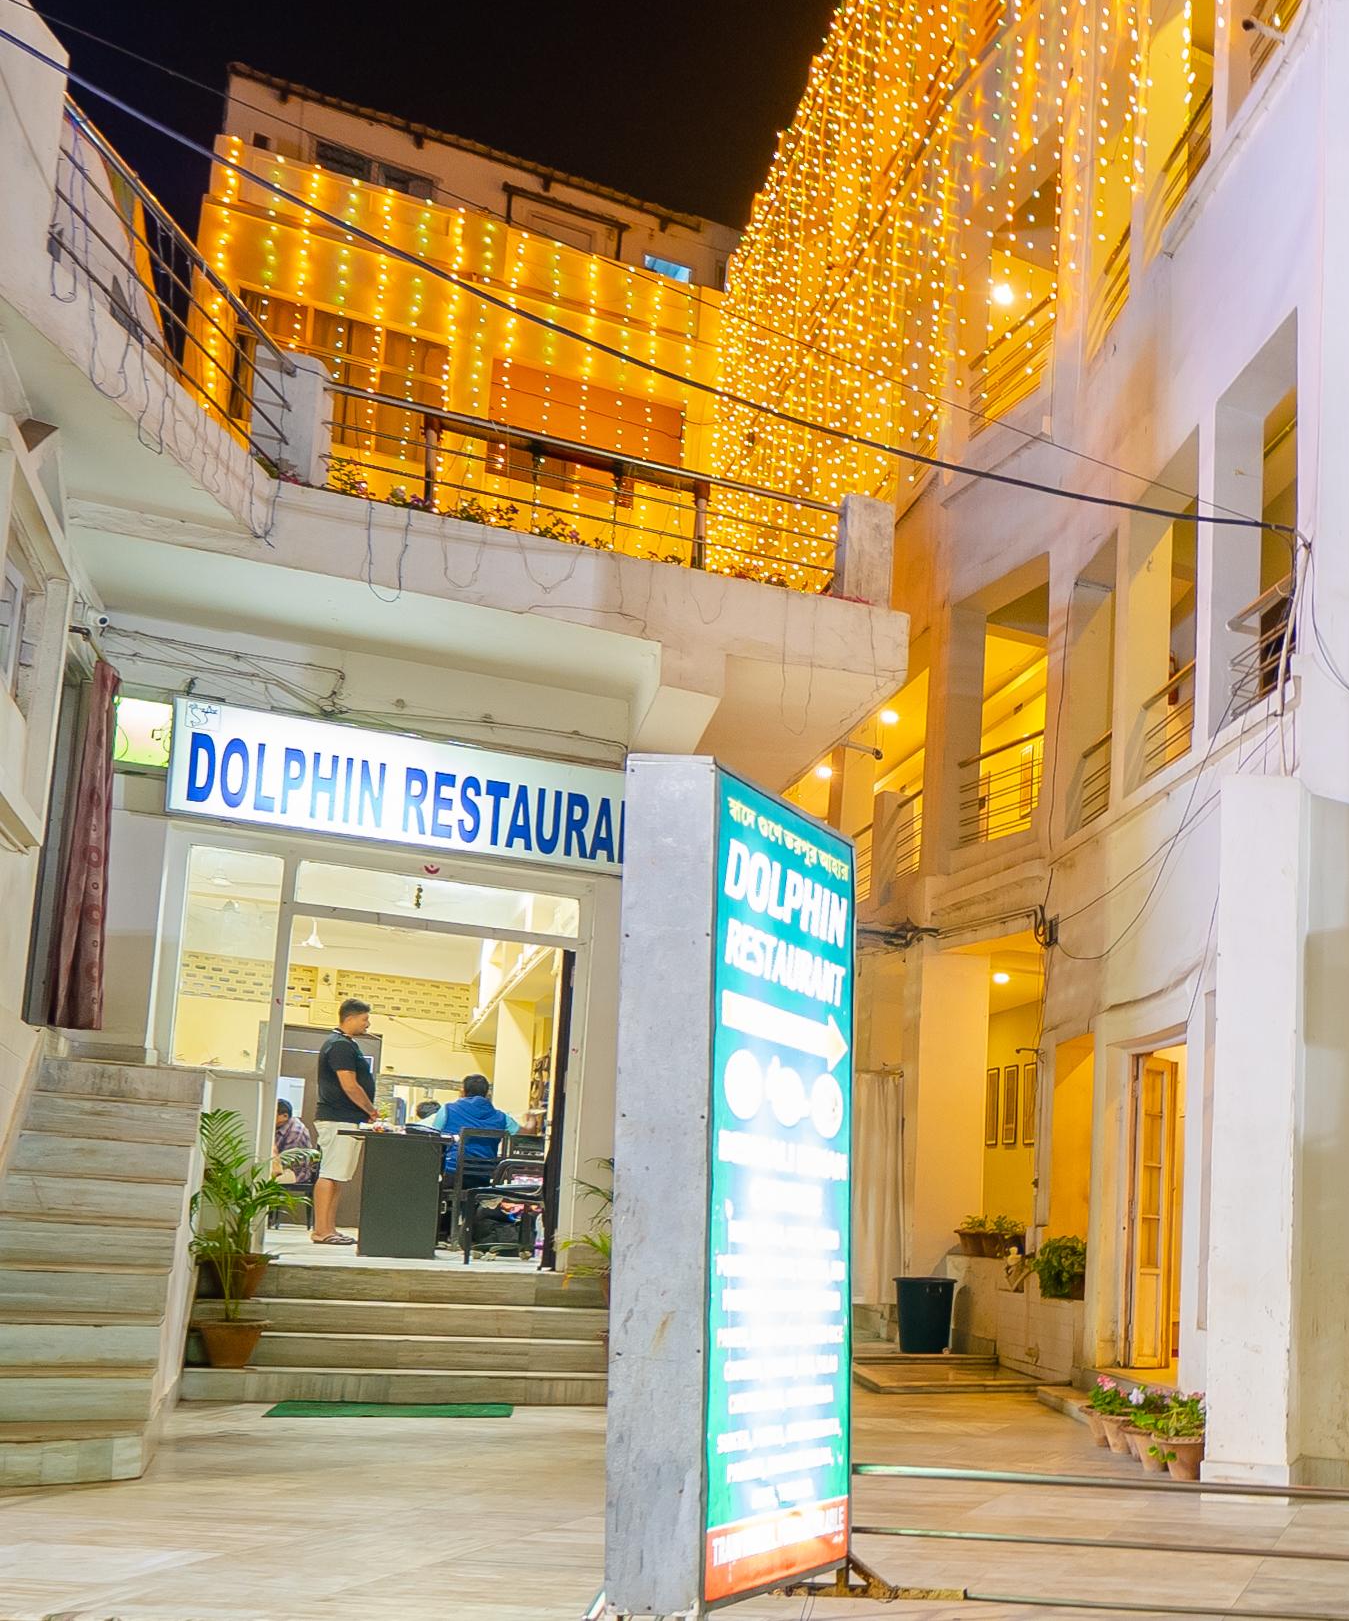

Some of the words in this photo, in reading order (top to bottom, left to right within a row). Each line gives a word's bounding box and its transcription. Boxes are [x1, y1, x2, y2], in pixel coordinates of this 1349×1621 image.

[186, 731, 386, 828] DOLPHIN
[724, 837, 848, 949] DOLPHIN
[724, 917, 846, 1008] RESTAURANT
